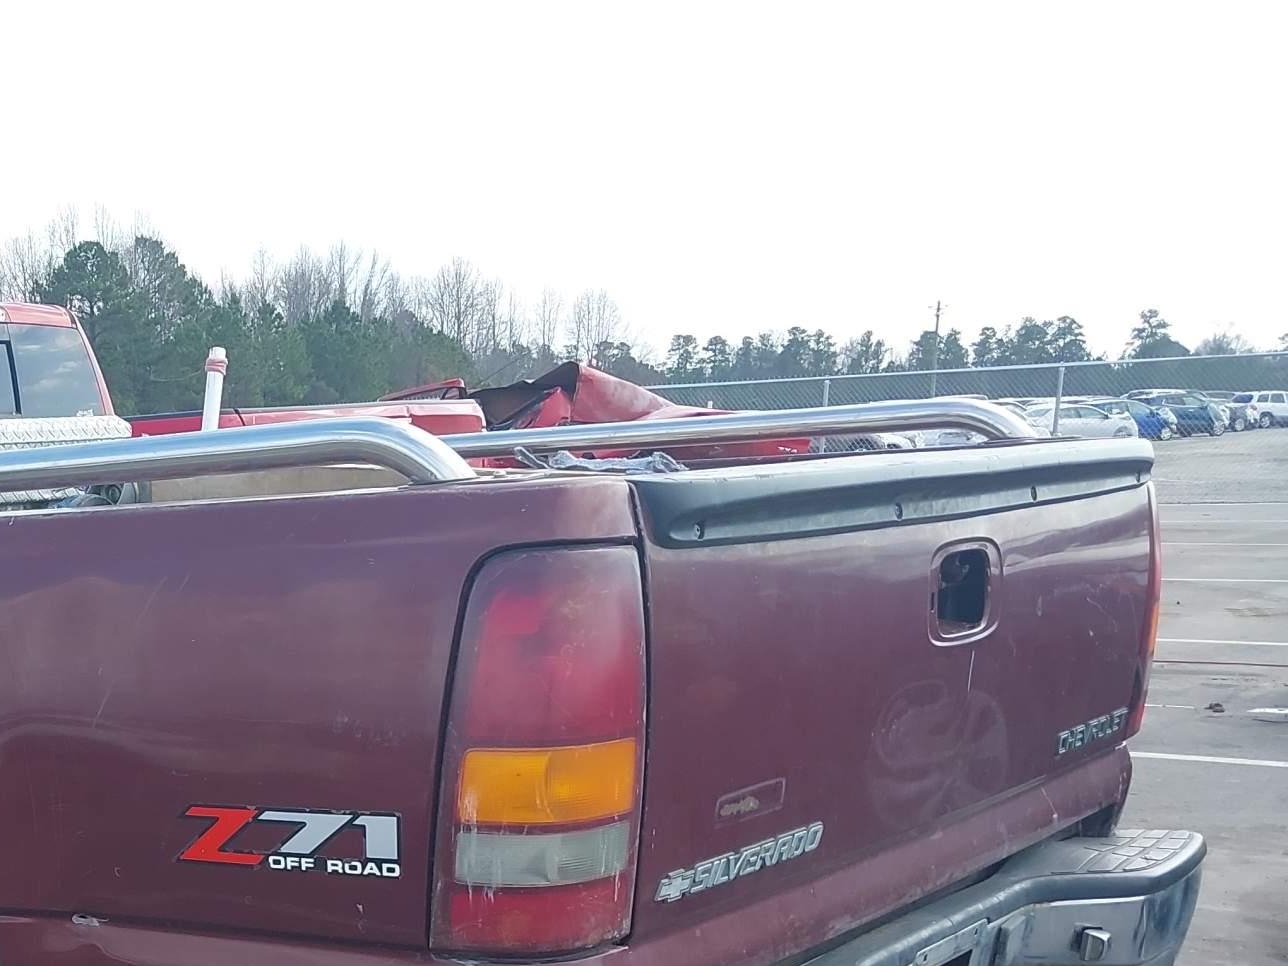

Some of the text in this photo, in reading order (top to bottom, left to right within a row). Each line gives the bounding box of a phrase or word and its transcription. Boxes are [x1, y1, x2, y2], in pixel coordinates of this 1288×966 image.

[1057, 707, 1128, 754] CHEVROLET
[179, 806, 399, 865] Z71
[690, 821, 824, 894] SILVERADO
[268, 855, 401, 877] OFF ROAD
